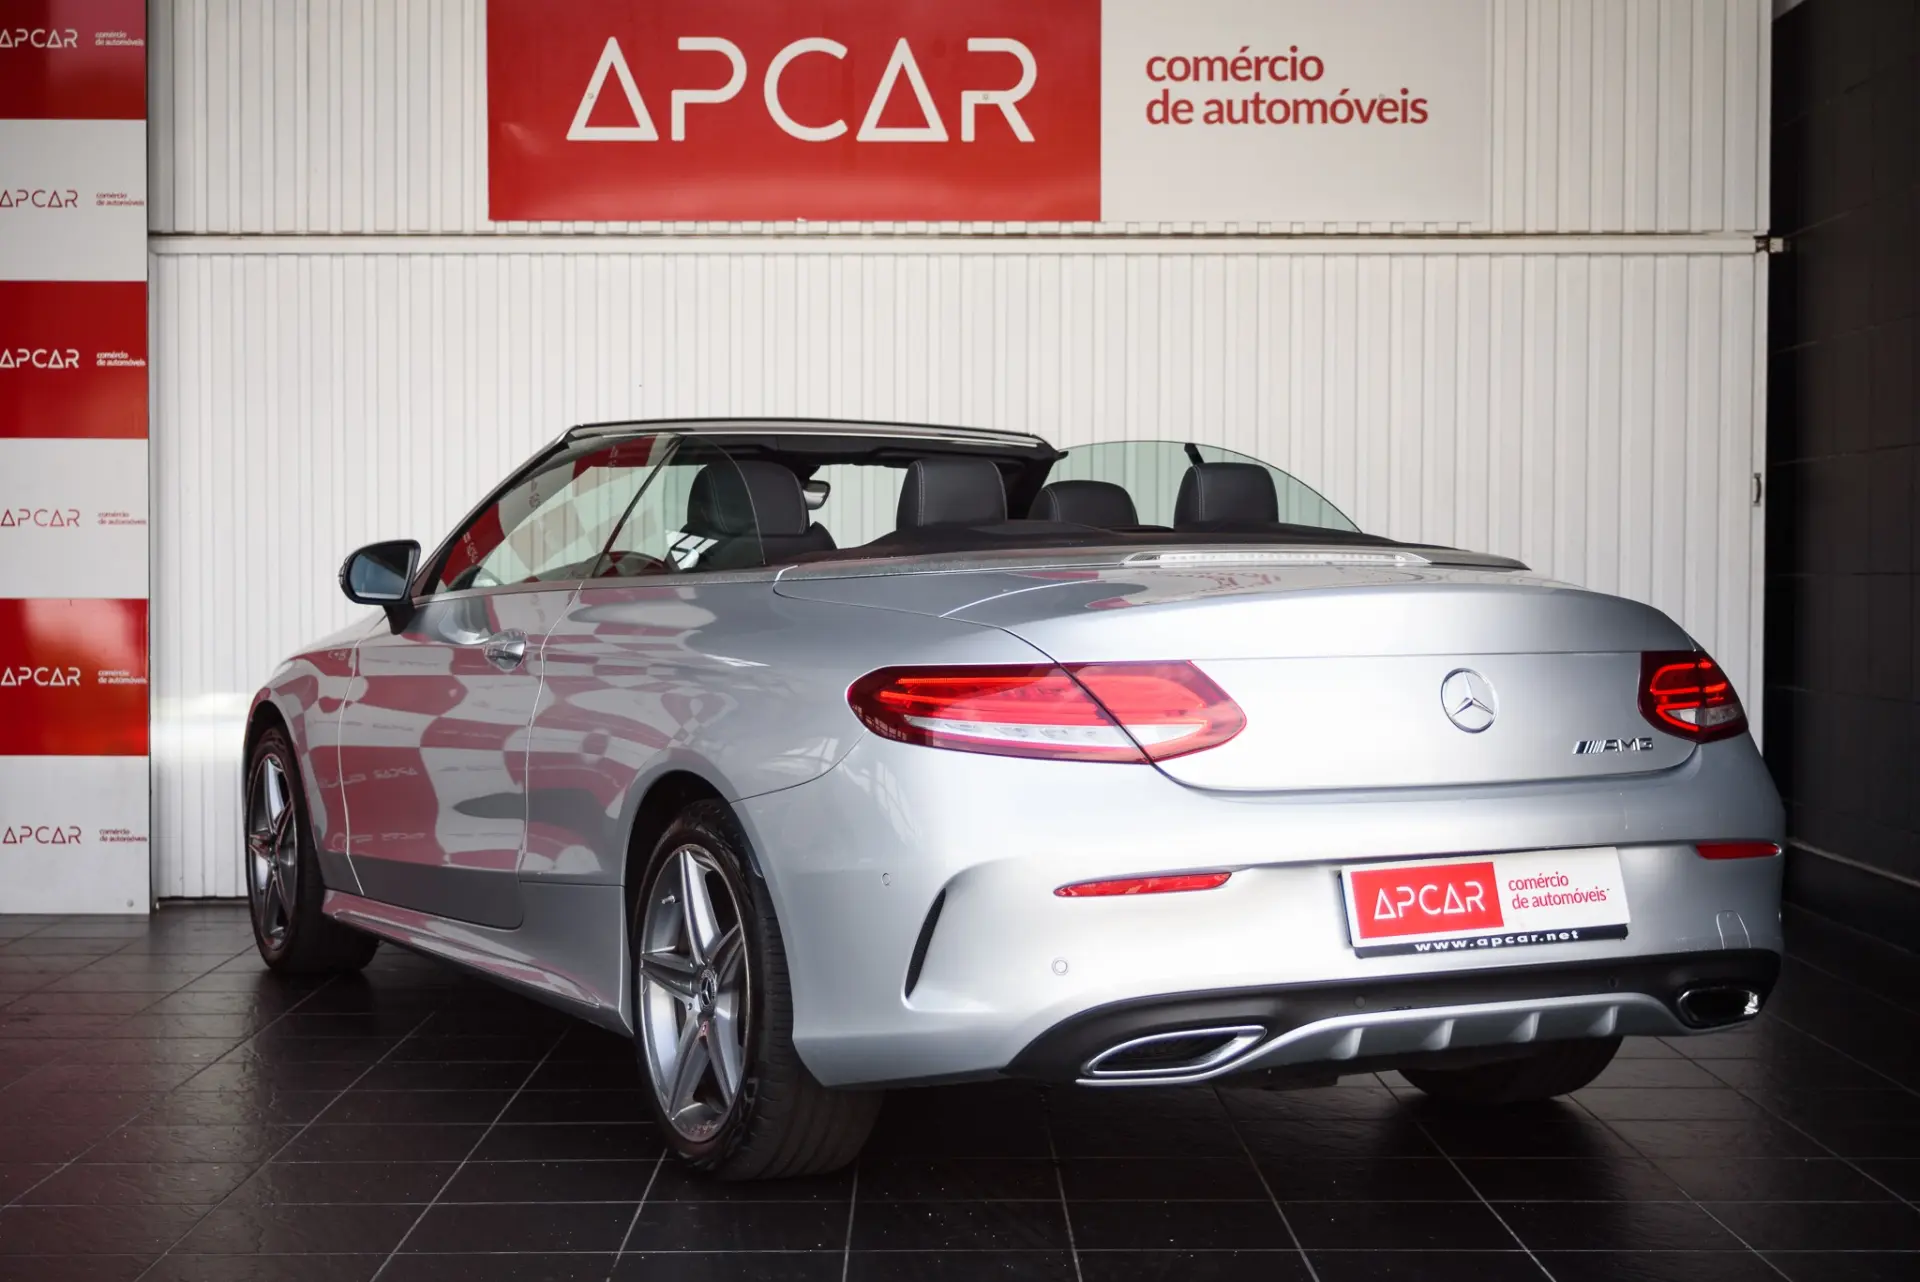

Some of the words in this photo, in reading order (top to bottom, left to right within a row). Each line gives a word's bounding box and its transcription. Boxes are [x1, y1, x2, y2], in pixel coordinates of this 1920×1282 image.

[0, 28, 78, 48] APCAR
[95, 38, 104, 46] de
[1146, 45, 1324, 82] comércio
[565, 36, 1037, 144] APCAR
[1146, 88, 1194, 125] de
[1202, 87, 1428, 125] automóveis
[0, 189, 78, 208] APCAR
[0, 348, 79, 368] APCAR
[96, 358, 106, 366] de
[1, 509, 80, 527] APCAR
[1, 666, 81, 686] APCAR
[1600, 737, 1653, 753] AMG
[2, 825, 81, 844] APCAR
[1508, 871, 1569, 892] comércio
[1373, 881, 1486, 920] APCAR
[1511, 891, 1530, 910] de
[1532, 885, 1607, 908] automóveis
[1414, 929, 1580, 952] www.apcar.net
